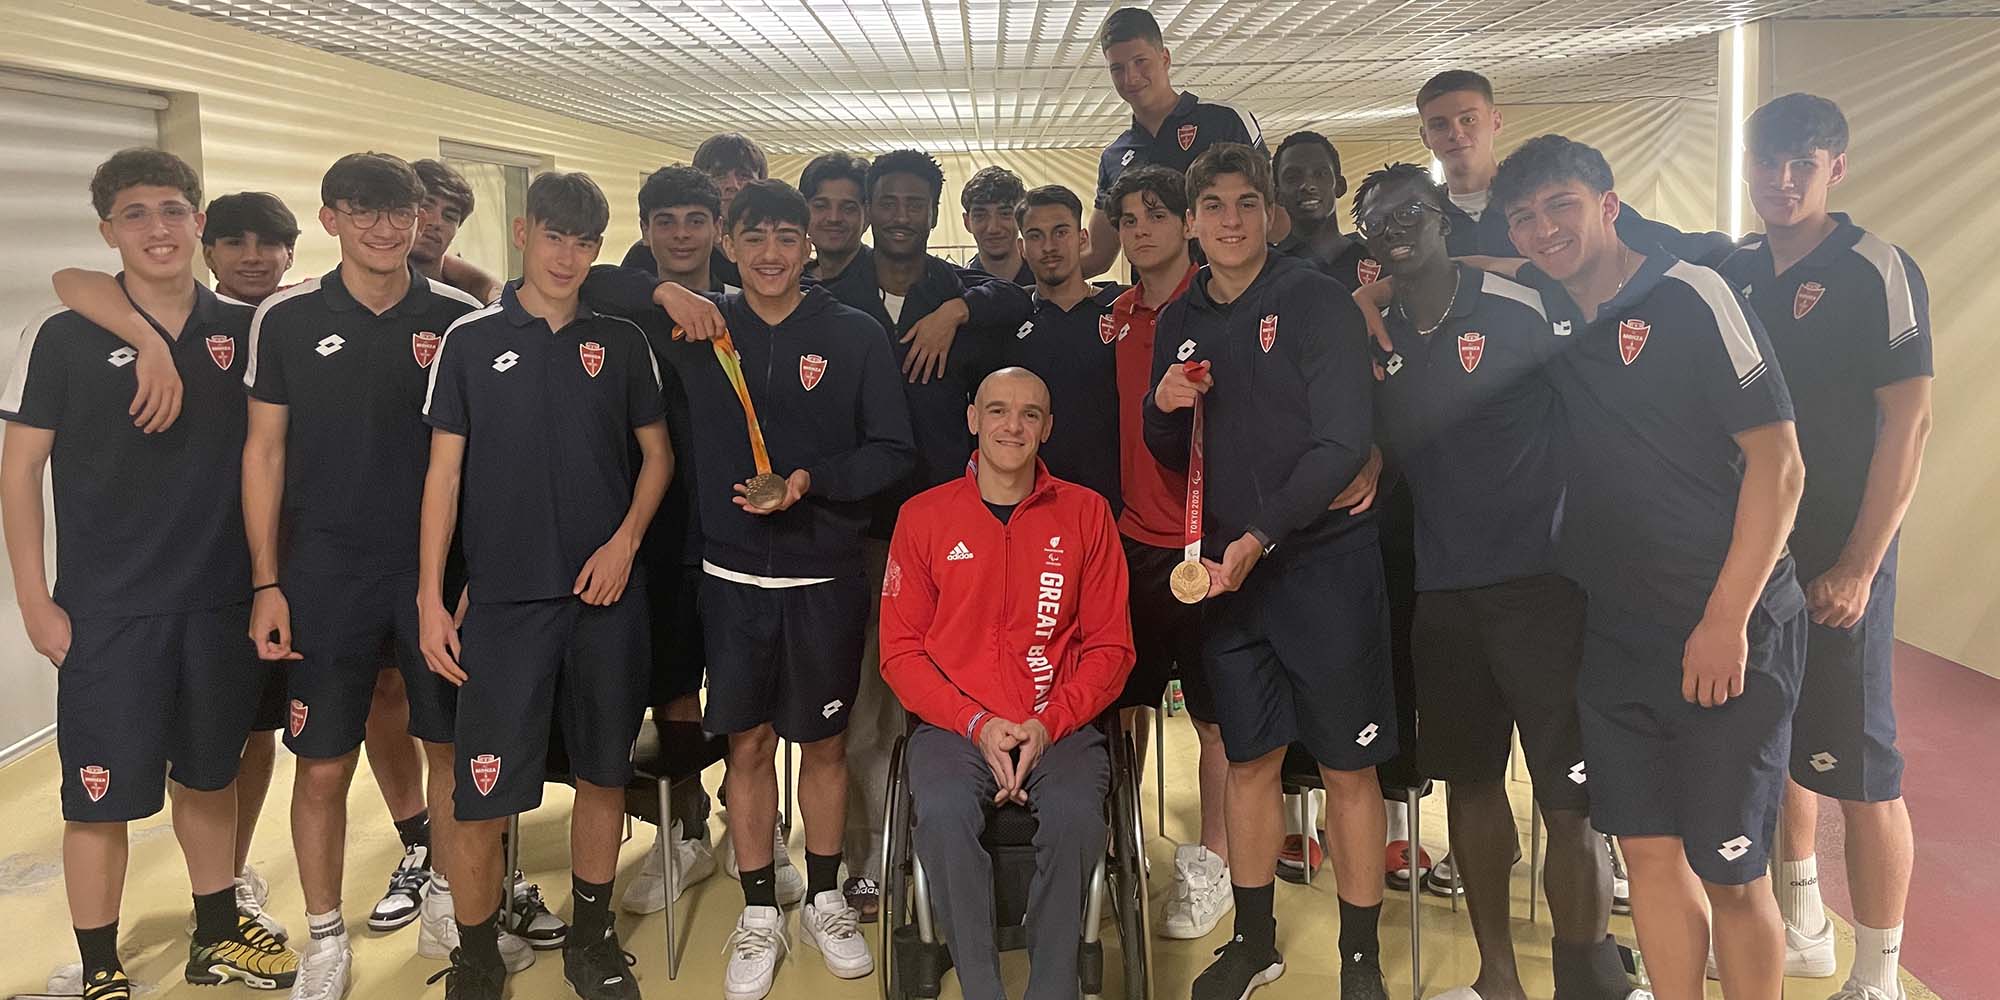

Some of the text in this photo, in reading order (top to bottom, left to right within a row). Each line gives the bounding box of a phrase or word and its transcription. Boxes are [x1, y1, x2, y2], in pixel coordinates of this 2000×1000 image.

[1190, 489, 1201, 534] TOKYO 2020
[947, 552, 974, 561] adidas
[1036, 572, 1064, 640] GREAT
